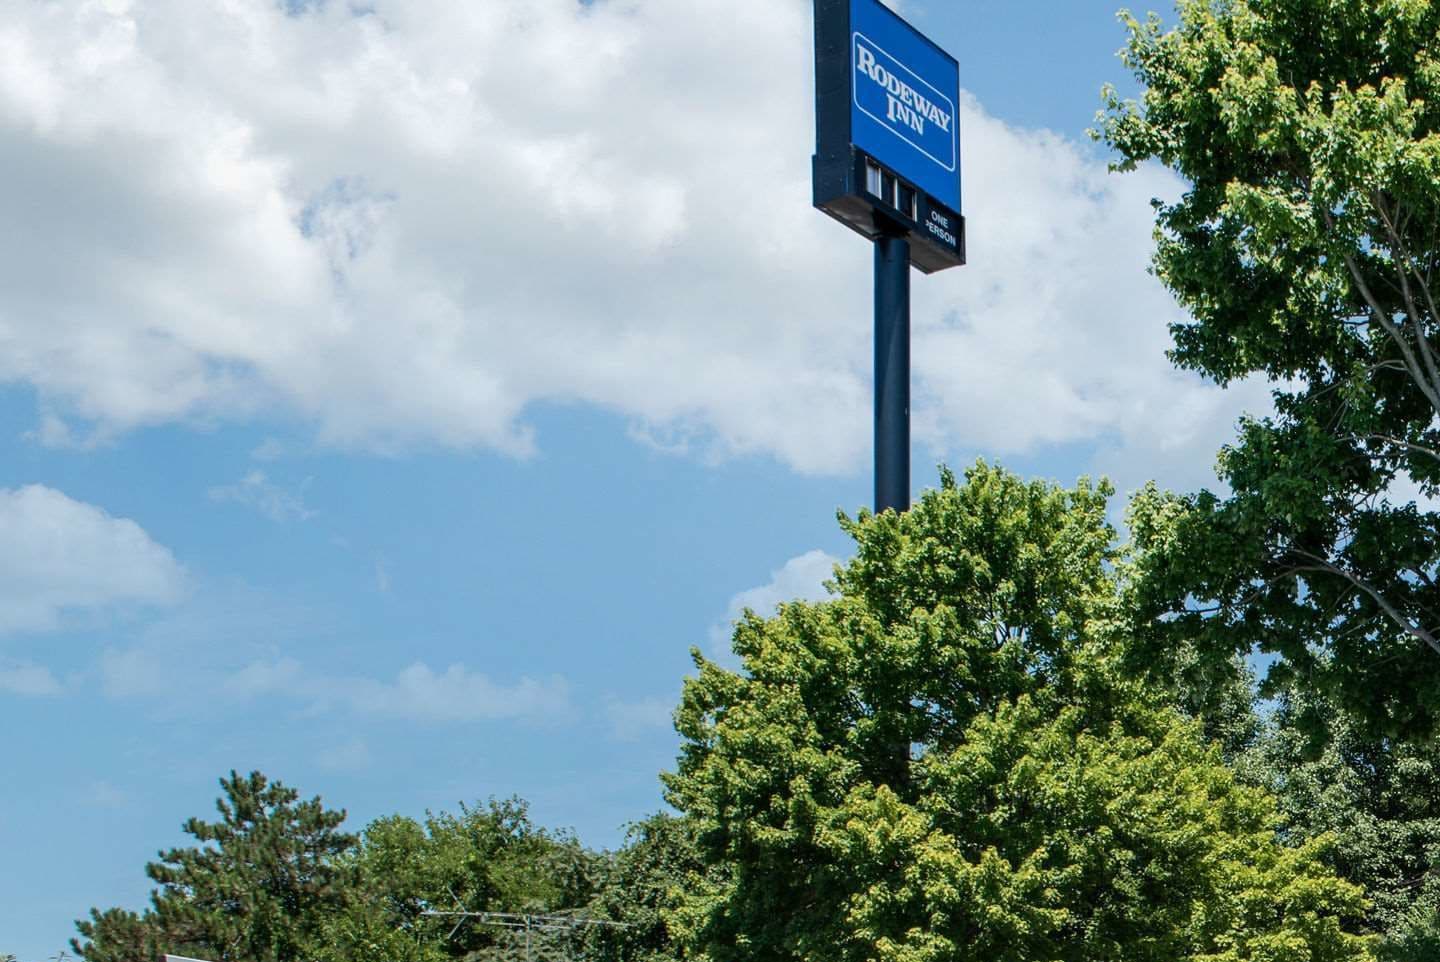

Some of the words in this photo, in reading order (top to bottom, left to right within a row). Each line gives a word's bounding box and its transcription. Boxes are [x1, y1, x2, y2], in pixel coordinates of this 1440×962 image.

[857, 44, 950, 132] RODEWAY
[886, 92, 924, 135] INN
[931, 211, 948, 228] ONE
